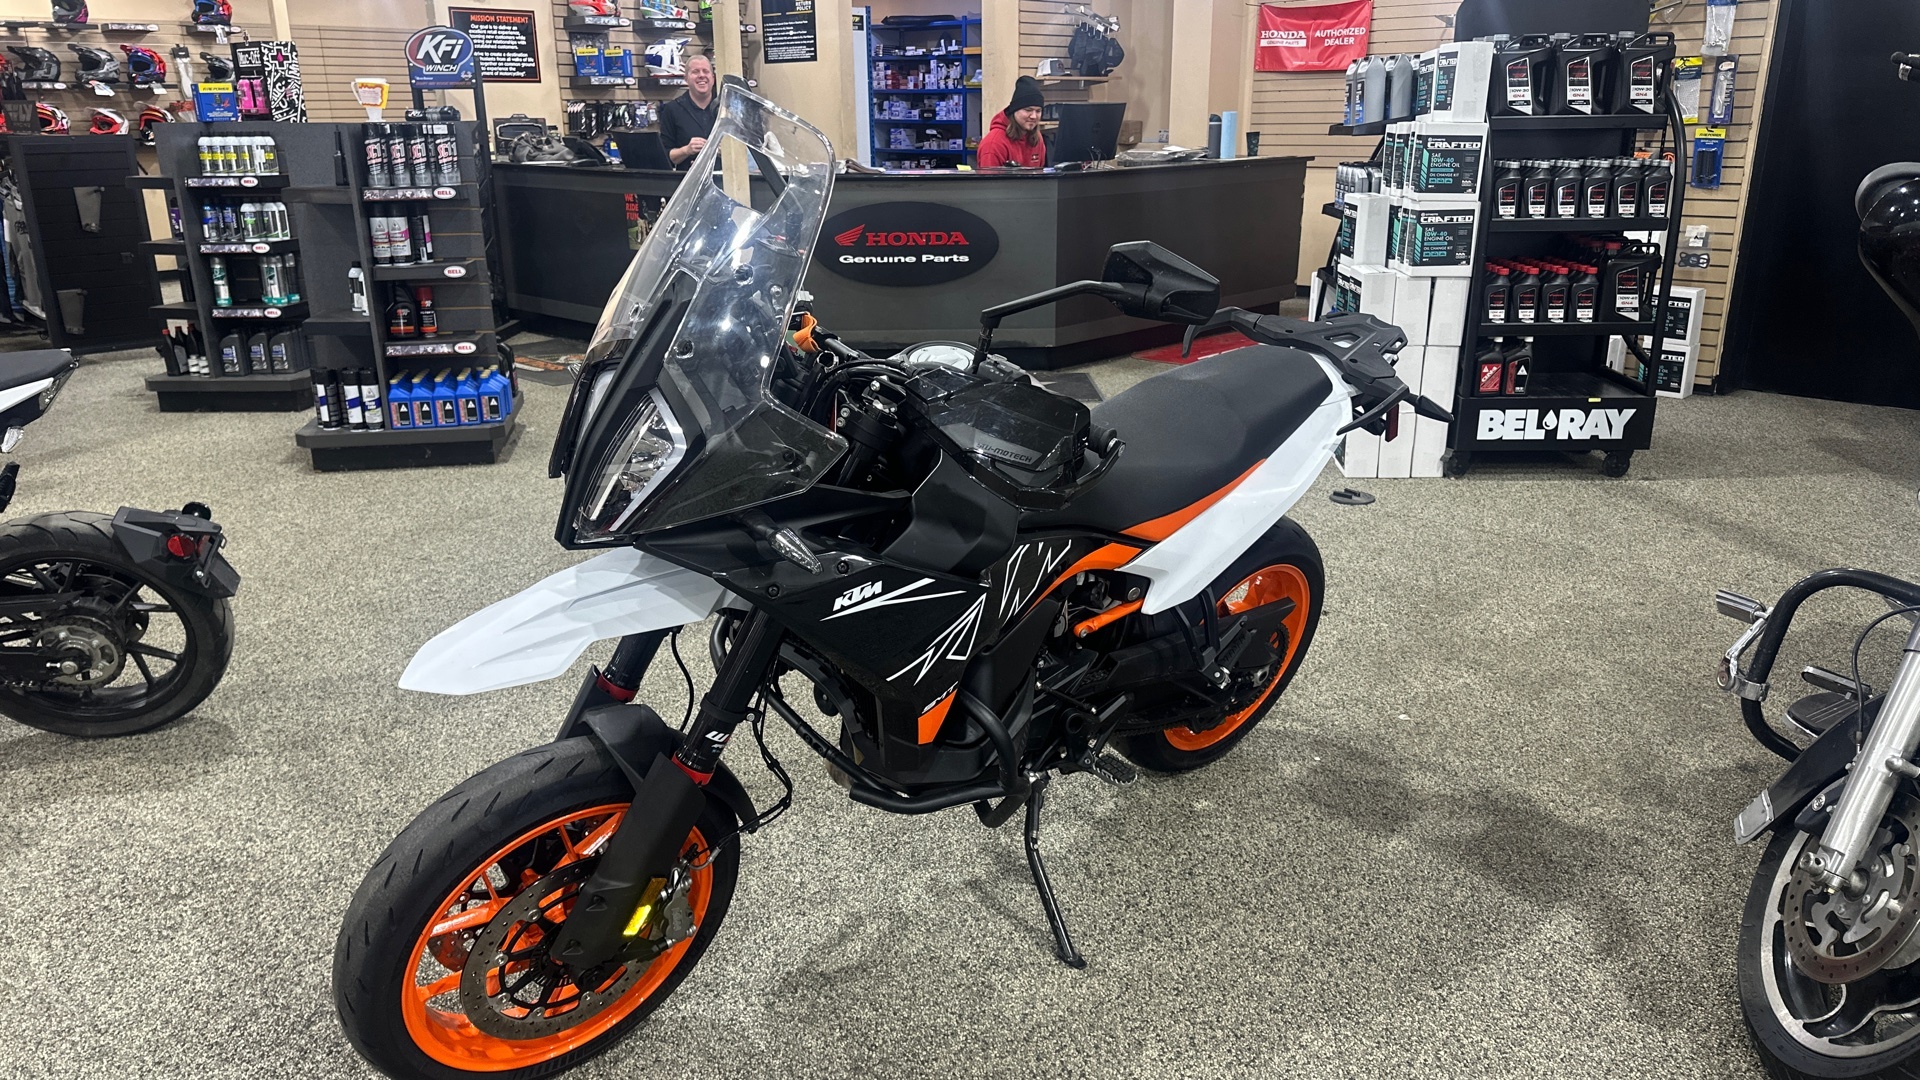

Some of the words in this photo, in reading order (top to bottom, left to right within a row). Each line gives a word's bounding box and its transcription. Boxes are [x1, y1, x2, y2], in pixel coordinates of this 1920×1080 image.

[470, 14, 495, 22] MISSION
[496, 15, 529, 24] STATEMENT
[1260, 30, 1307, 39] HONDA
[1314, 27, 1366, 38] AUTHORIZED
[1324, 37, 1355, 46] DEALER
[425, 64, 458, 72] WINCH
[1427, 141, 1481, 149] CRAFTED
[1420, 215, 1474, 223] CRAFTED
[866, 231, 970, 247] HONDA
[839, 254, 916, 264] Genuine
[921, 253, 970, 263] Parts
[832, 580, 883, 612] KTM
